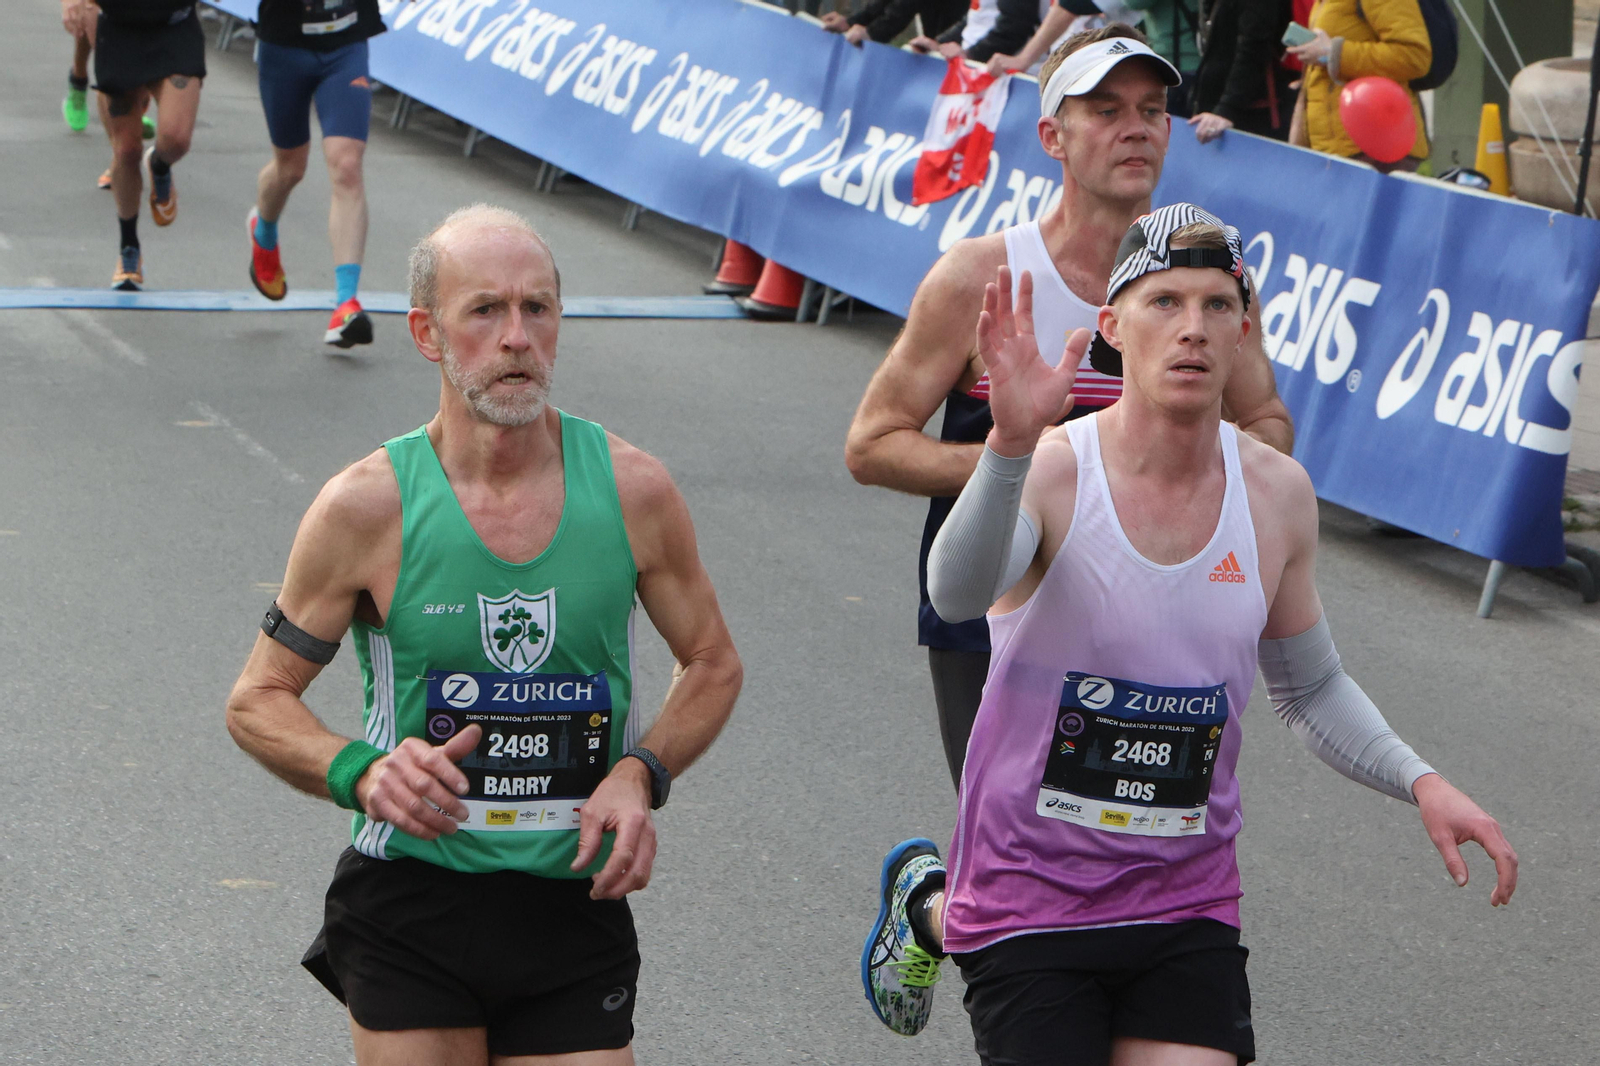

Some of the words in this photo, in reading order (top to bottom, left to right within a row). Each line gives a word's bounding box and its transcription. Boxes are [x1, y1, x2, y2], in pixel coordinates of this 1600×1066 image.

[657, 65, 740, 144] asics
[1434, 311, 1586, 456] asics
[1208, 571, 1246, 583] adidas
[492, 682, 593, 703] ZURICH
[1124, 690, 1217, 715] ZURICH
[490, 714, 522, 723] MARATÓN
[1095, 716, 1118, 727] ZURICH
[487, 733, 549, 759] 2498
[1111, 739, 1172, 766] 2468
[589, 755, 596, 764] S
[483, 775, 553, 796] BARRY
[1114, 778, 1157, 802] BOS
[1057, 801, 1083, 813] asics
